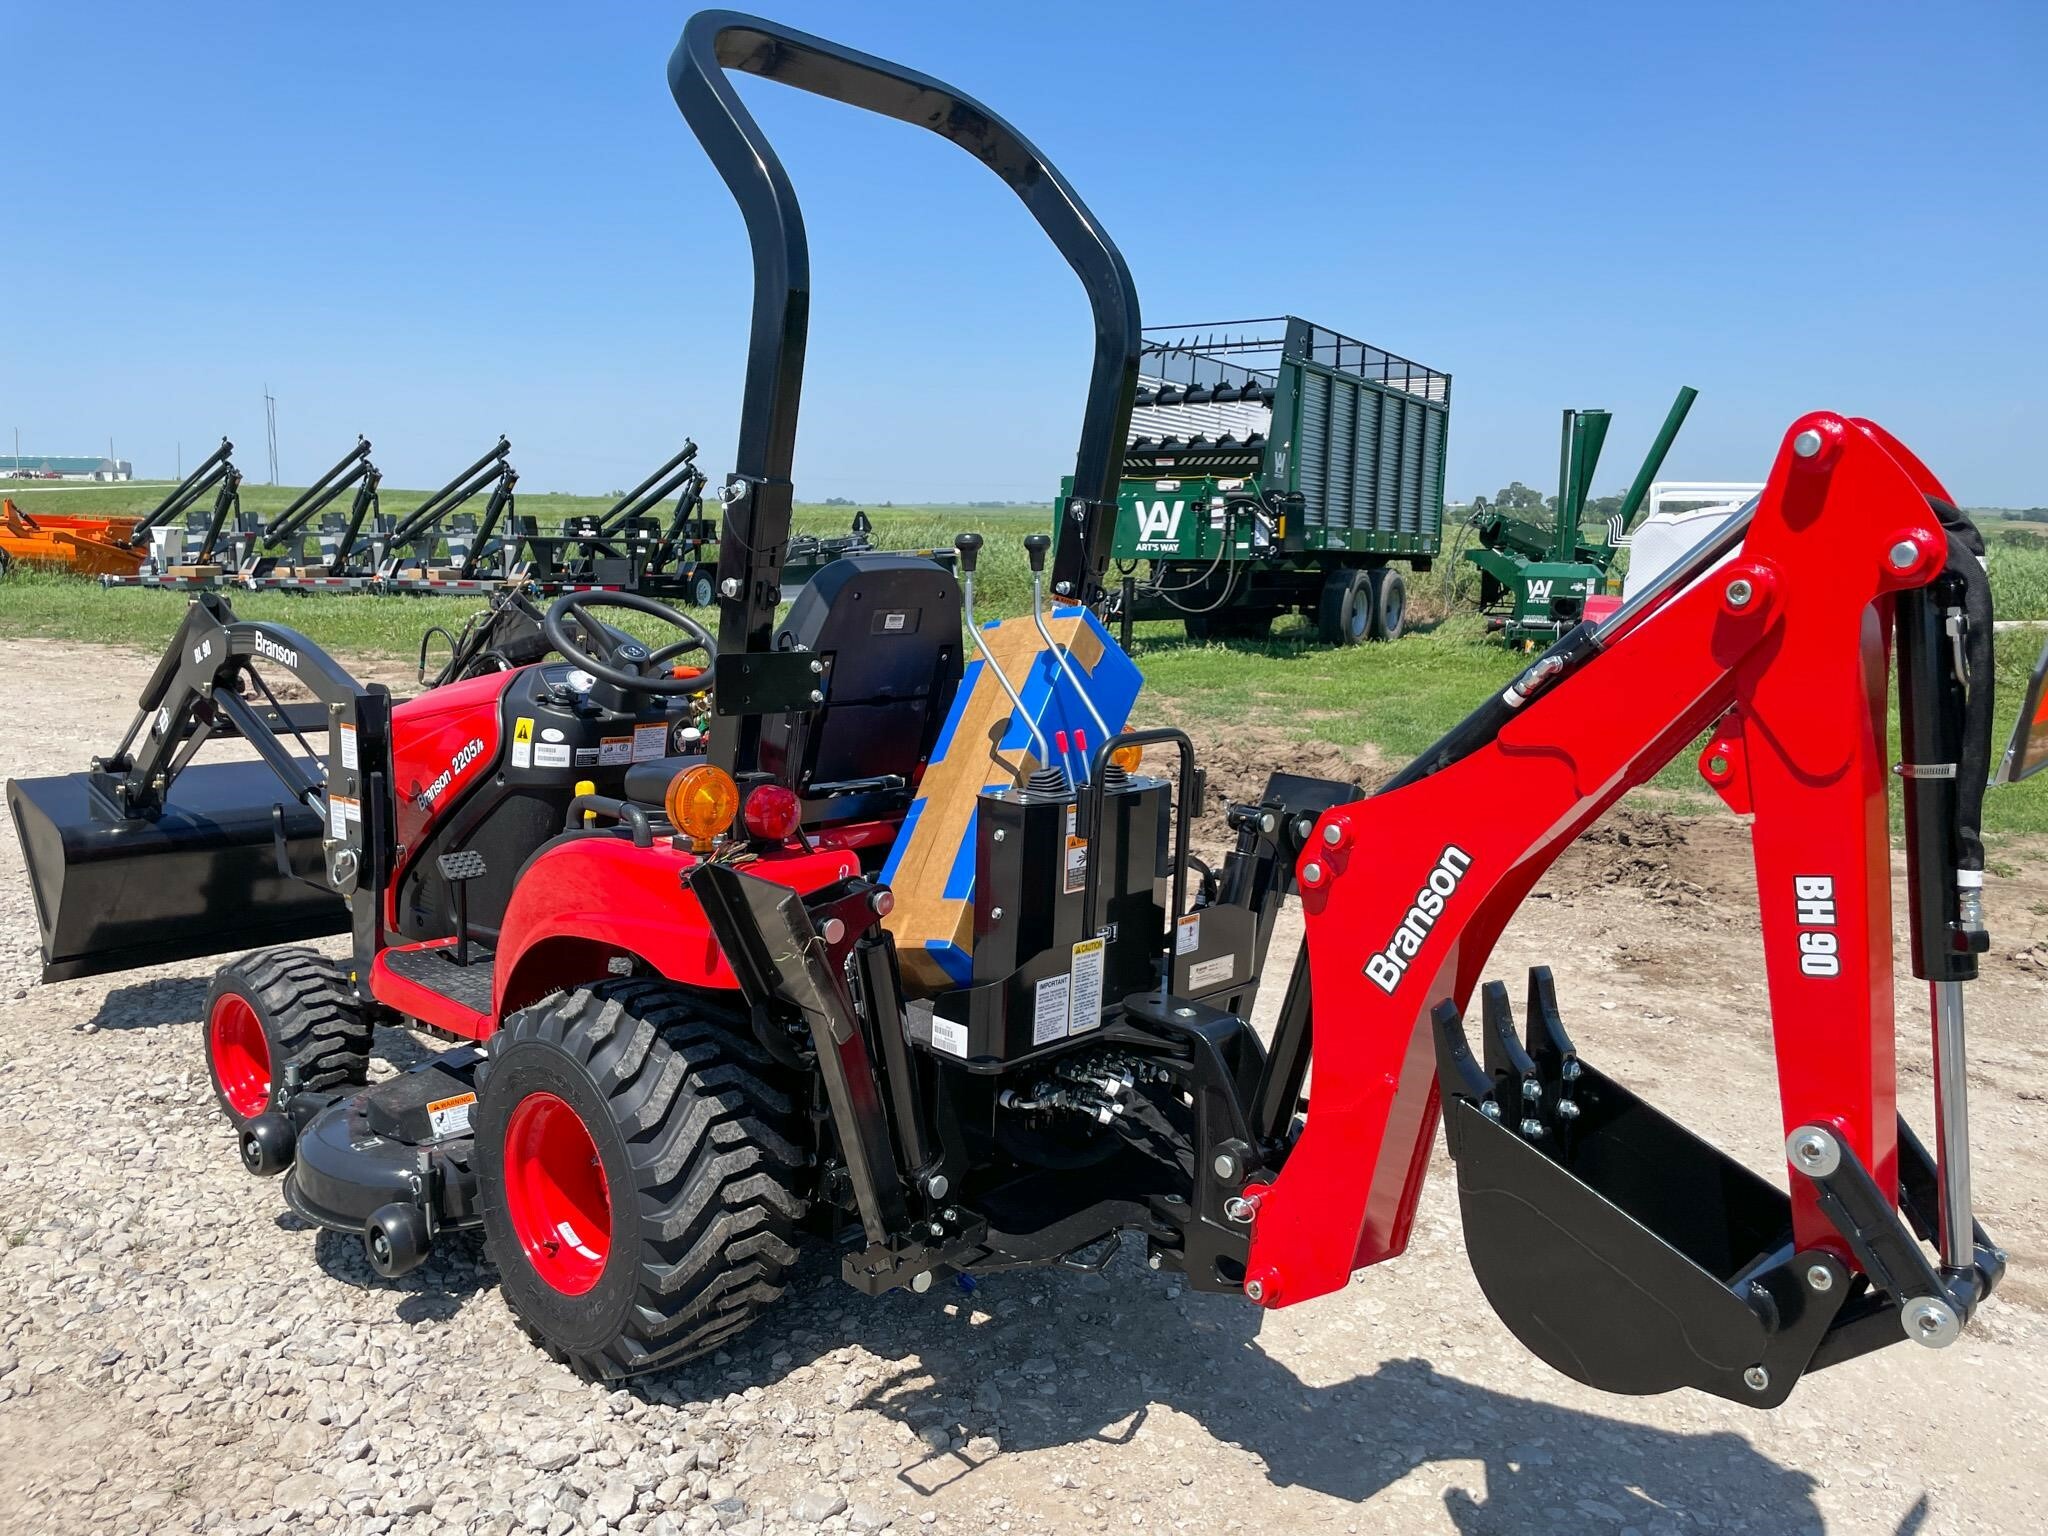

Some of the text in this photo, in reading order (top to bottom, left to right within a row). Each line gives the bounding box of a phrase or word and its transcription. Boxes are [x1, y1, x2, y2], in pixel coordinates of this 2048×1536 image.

[1135, 543, 1180, 551] ART'S WAY
[193, 639, 212, 665] BL 90
[255, 629, 298, 669] Branson
[416, 769, 452, 812] Branson
[451, 738, 485, 776] 2205h
[1363, 845, 1473, 994] Branson
[1794, 876, 1840, 977] BH 90
[1040, 977, 1068, 989] IMPORTANT
[441, 1095, 472, 1109] WARNING
